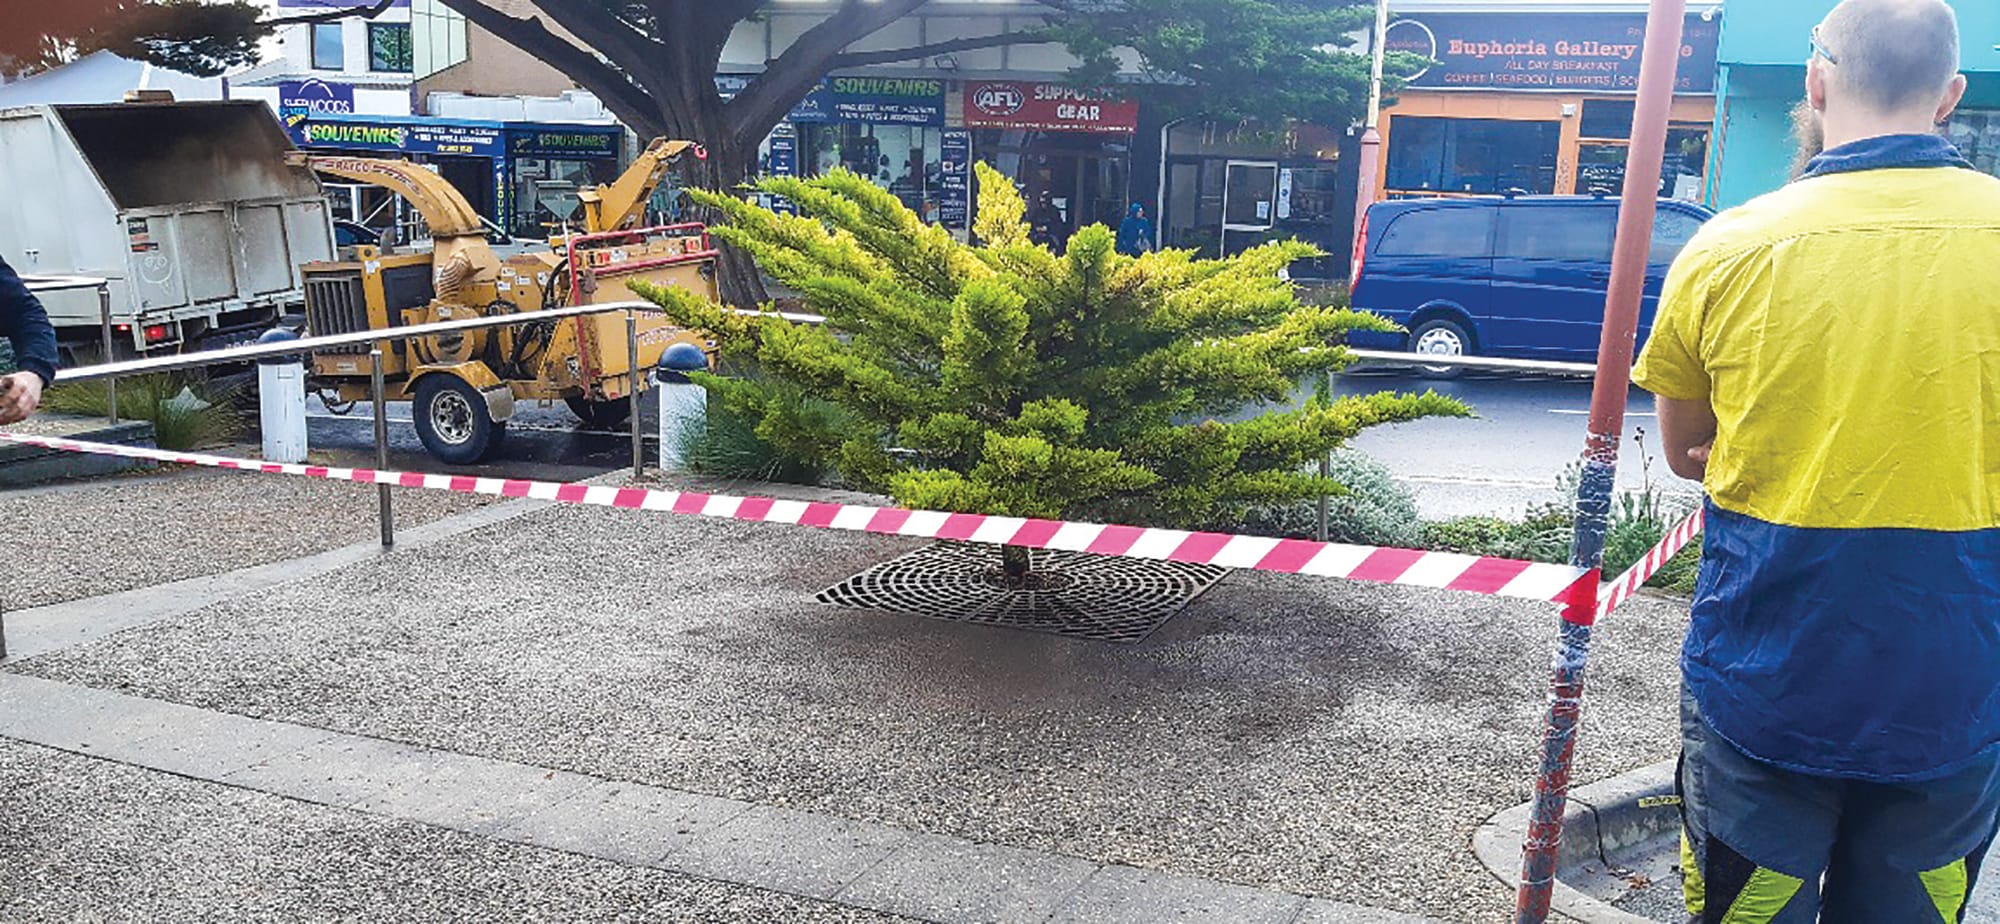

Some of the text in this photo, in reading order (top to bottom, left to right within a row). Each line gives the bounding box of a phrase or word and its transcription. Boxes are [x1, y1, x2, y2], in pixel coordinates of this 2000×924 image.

[1448, 38, 1638, 60] Euphoria Gallery
[1504, 60, 1619, 71] ALL DAY BREAKFAST
[1444, 72, 1488, 83] COFFEE
[1495, 73, 1547, 84] SEAFOOD
[1556, 75, 1611, 86] BURGERS
[833, 77, 941, 97] SOUVENIRS
[979, 92, 1018, 107] AFL
[1057, 103, 1100, 121] GEAR
[311, 124, 402, 144] SOUVENIRS
[544, 134, 609, 146] SOUVENIRS
[335, 160, 371, 173] RAYCO
